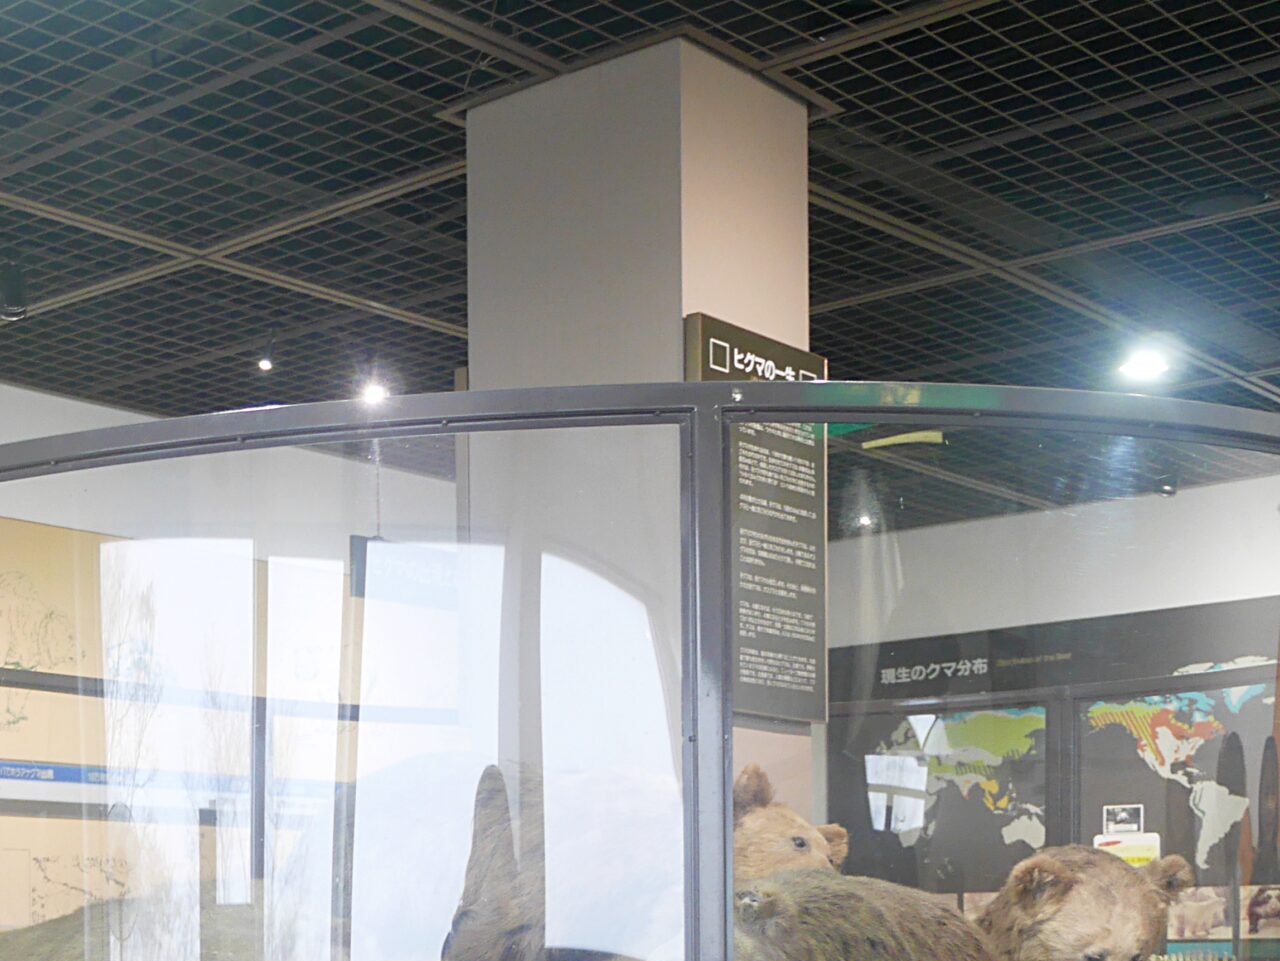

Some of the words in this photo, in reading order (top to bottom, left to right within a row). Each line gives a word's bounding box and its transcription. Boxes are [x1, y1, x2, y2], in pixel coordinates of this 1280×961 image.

[733, 347, 796, 381] ヒグマの一生
[880, 658, 988, 684] 現生のクマ分布
